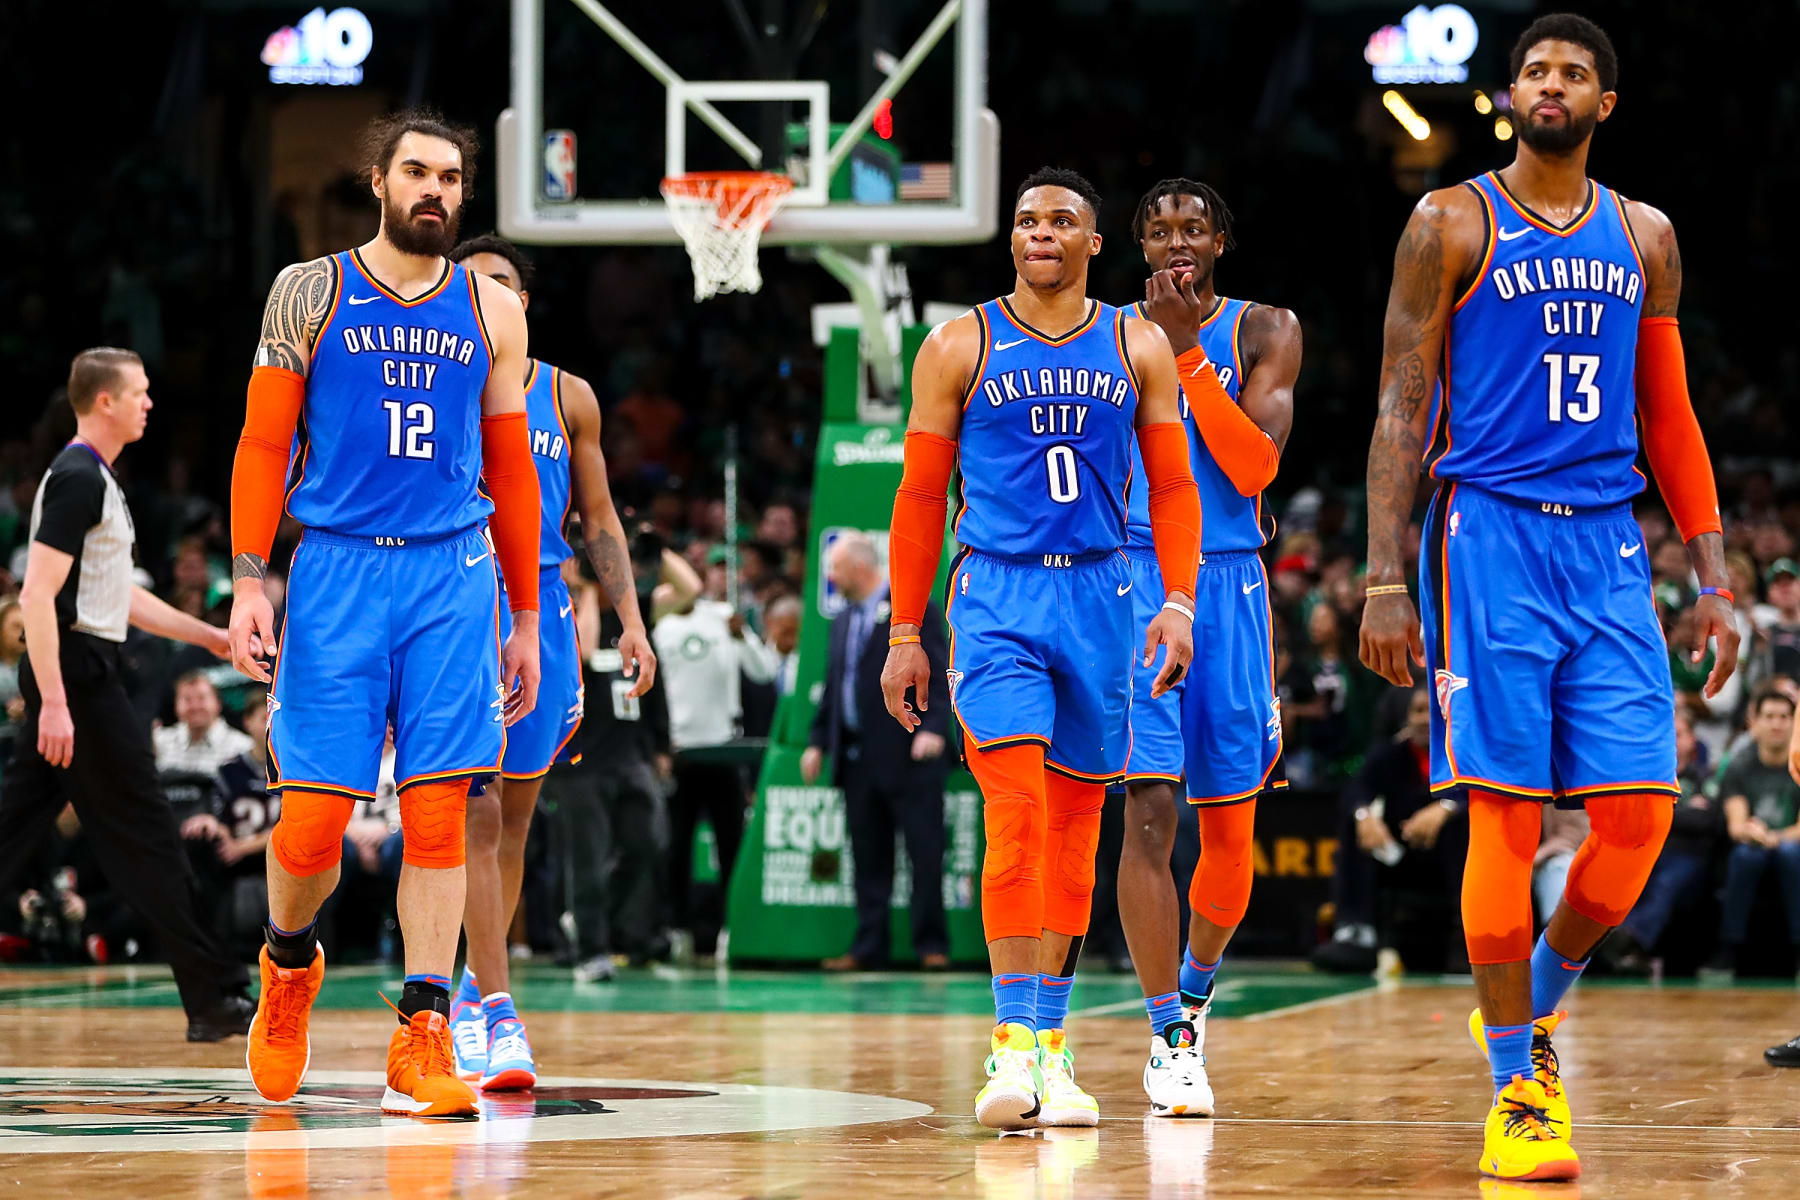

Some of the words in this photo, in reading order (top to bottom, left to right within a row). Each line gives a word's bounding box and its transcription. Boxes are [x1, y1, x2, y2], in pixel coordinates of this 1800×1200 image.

[297, 6, 373, 68] 10
[1401, 3, 1479, 65] 10
[1492, 256, 1641, 305] OKLAHOMA
[1543, 301, 1604, 336] CITY
[342, 325, 476, 366] OKLAHOMA
[383, 359, 438, 390] CITY
[983, 367, 1129, 410] OKLAHOMA
[1543, 353, 1601, 423] 13
[382, 399, 435, 461] 12
[1030, 404, 1088, 435] CITY
[1045, 443, 1081, 504] 0
[764, 808, 847, 850] EQU
